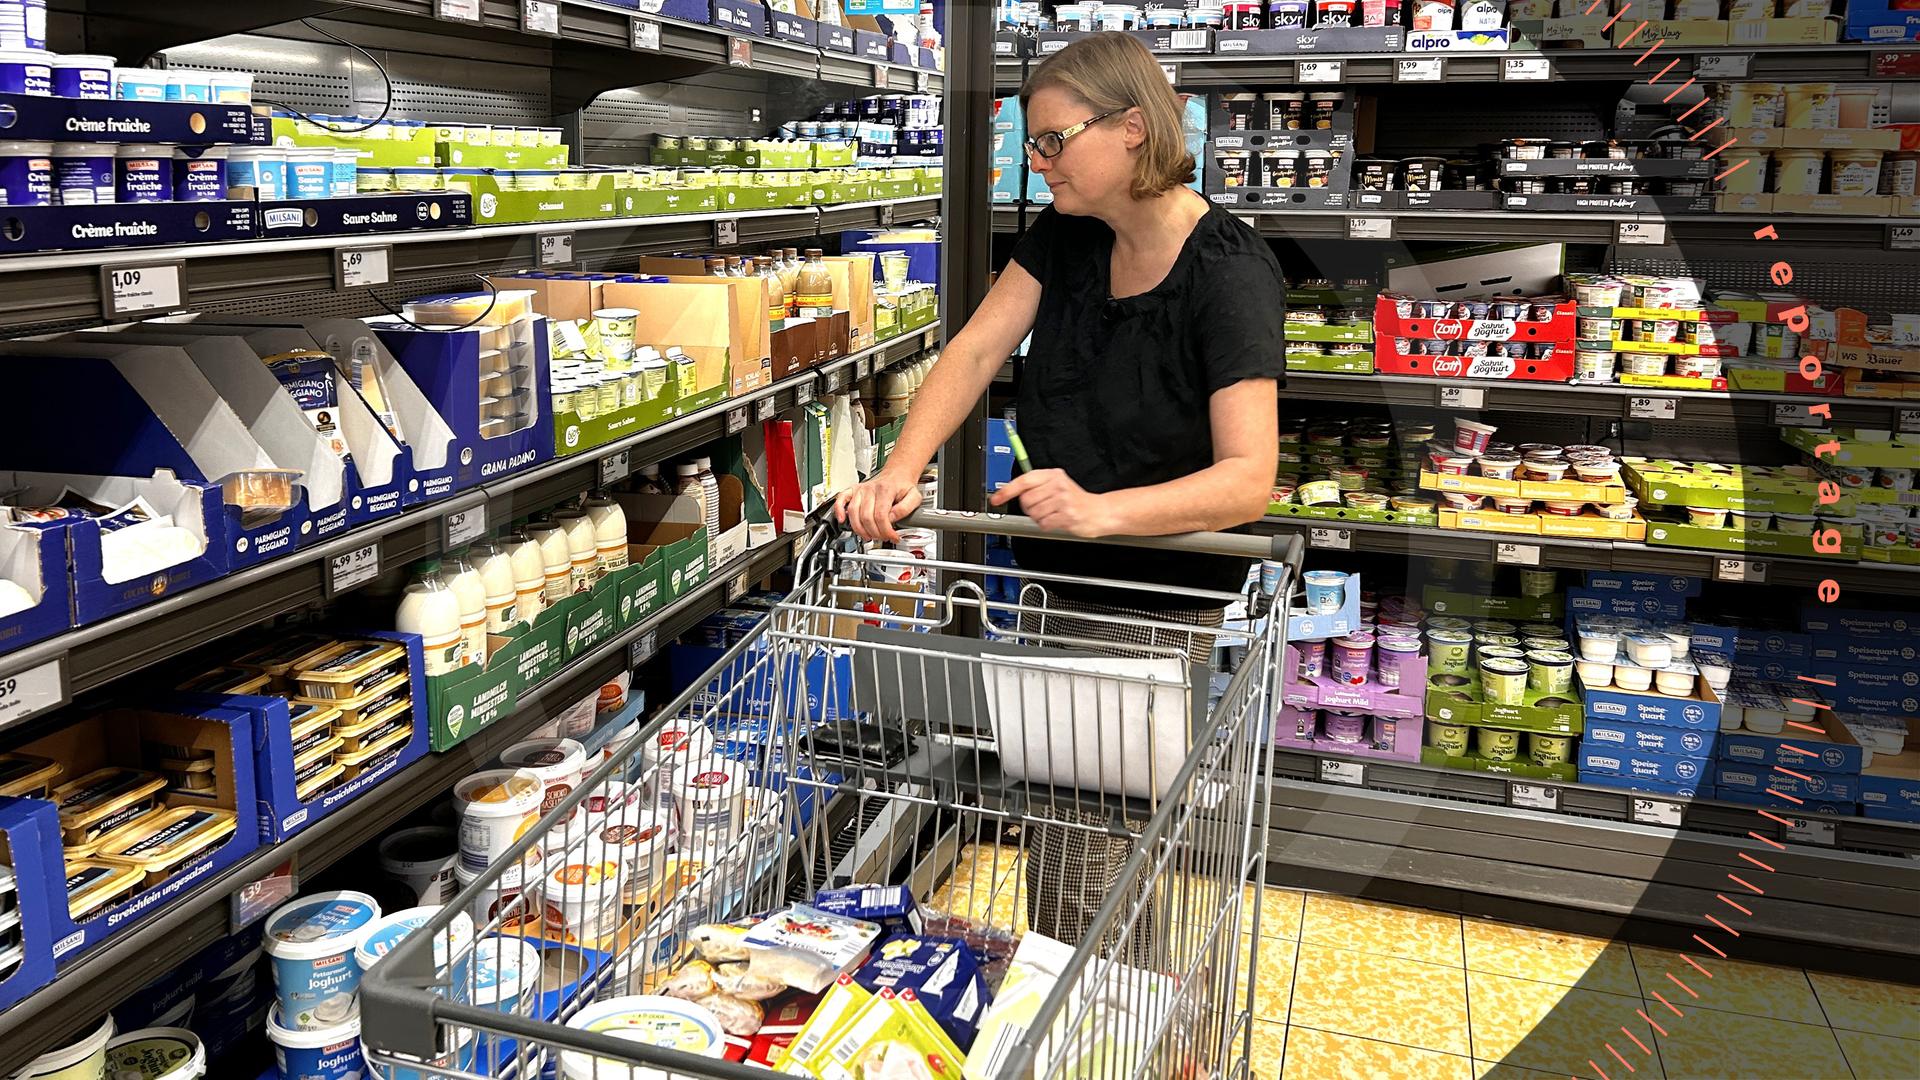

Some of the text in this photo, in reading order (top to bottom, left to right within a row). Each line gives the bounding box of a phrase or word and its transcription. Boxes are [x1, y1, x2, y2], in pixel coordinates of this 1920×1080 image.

[1477, 2, 1498, 14] alpro
[1274, 12, 1303, 27] skyr
[1321, 12, 1352, 27] skyr
[1296, 34, 1319, 46] skyr
[1411, 36, 1450, 50] alpro
[1400, 61, 1418, 72] 1,99
[1506, 60, 1525, 71] 1,35
[1700, 57, 1721, 68] -,99
[1876, 54, 1899, 67] -,99
[1300, 62, 1317, 73] 1,69
[66, 116, 151, 134] Crème fraîche
[126, 172, 160, 183] Crème
[187, 172, 218, 183] Crème
[126, 181, 163, 193] fraîche
[187, 181, 223, 193] fraîche
[268, 212, 301, 225] MILSANI
[342, 211, 398, 226] Saure Sahne
[1350, 219, 1367, 230] 1,19
[71, 220, 158, 239] Crème fraîche
[1620, 223, 1640, 234] -,99
[1891, 227, 1914, 241] 1,49
[342, 253, 363, 271] -,69
[111, 270, 141, 293] 1,09
[1435, 322, 1461, 335] Zott
[1480, 322, 1505, 331] Sahne
[1473, 327, 1510, 339] Joghurt
[1479, 359, 1505, 368] Sahne
[1841, 351, 1904, 366] WS Bauer
[1435, 359, 1461, 373] Zott
[1473, 364, 1509, 376] Joghurt
[282, 380, 326, 391] RMIGIANO
[290, 388, 323, 398] GGIANO
[1441, 388, 1460, 398] -,89
[1631, 398, 1651, 409] -,89
[1775, 405, 1797, 417] -,99
[481, 448, 536, 477] GRANA PADANO
[423, 475, 454, 488] PARMIGIANO
[425, 485, 450, 497] REGGIANO
[366, 491, 400, 506] PARMIGIANO
[369, 500, 397, 513] REGGIANO
[316, 508, 347, 528] PARMIGIANO
[447, 513, 466, 531] 4,29
[318, 519, 346, 535] REGGIANO
[254, 526, 291, 546] PARMIGIANO
[1311, 529, 1328, 540] -,85
[257, 538, 289, 554] REGGIANO
[332, 547, 373, 573] 4,99 5,99
[1720, 561, 1740, 572] -,59
[1612, 604, 1637, 614] quark
[519, 639, 548, 664] LANDMILCH
[1848, 645, 1900, 657] Speisequark
[517, 649, 550, 675] MINDESTENS
[363, 669, 389, 686] STREICHFEIN
[1848, 670, 1899, 682] Speisequark
[472, 680, 507, 706] LANDMILCH
[366, 695, 393, 713] STREICHFEIN
[470, 690, 509, 719] MINDESTENS
[1324, 695, 1370, 707] Joghurt Mild
[1595, 704, 1624, 714] MILSANI
[1637, 703, 1669, 715] Speise-
[1639, 712, 1667, 722] quark
[368, 721, 395, 740] STREICHFEIN
[1593, 730, 1623, 741] MILSANI
[1635, 730, 1667, 742] Speise-
[1637, 739, 1664, 750] quark
[1322, 762, 1340, 774] -,99
[1589, 757, 1618, 768] MILSANI
[1630, 758, 1662, 769] Speise-
[1632, 766, 1659, 777] quark
[323, 759, 397, 808] Streichfein ungesalzen
[1770, 783, 1798, 794] quark
[1635, 801, 1654, 812] -,79
[100, 806, 139, 830] STREICHFEIN
[126, 820, 189, 857] STREICHFEIN
[107, 860, 214, 928] Streichfein ungesalzen
[240, 880, 262, 906] 1,39
[54, 935, 81, 956] MILSANI
[314, 956, 344, 968] MILSANI
[312, 966, 347, 979] Fettarmer
[308, 970, 353, 991] Joghurt
[323, 986, 339, 996] mild
[323, 1039, 353, 1053] MILSANI
[317, 1047, 360, 1073] Joghurt
[333, 1063, 348, 1075] mild
